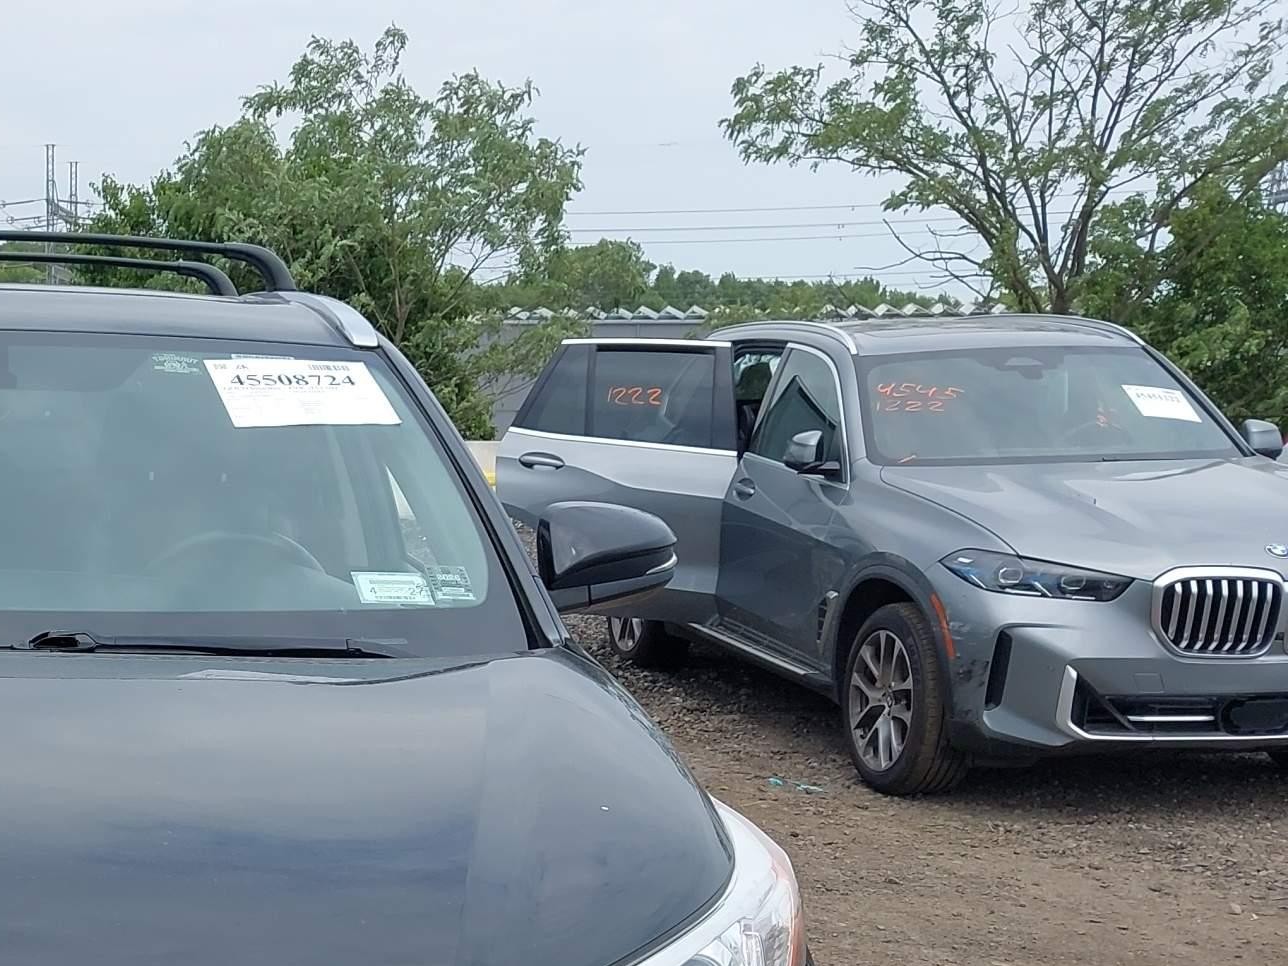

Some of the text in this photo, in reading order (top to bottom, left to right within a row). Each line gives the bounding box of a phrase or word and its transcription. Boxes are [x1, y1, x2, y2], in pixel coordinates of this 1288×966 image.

[230, 374, 355, 387] 45508724
[607, 386, 662, 406] 1222
[877, 383, 965, 399] 4545
[876, 400, 945, 412] 1222
